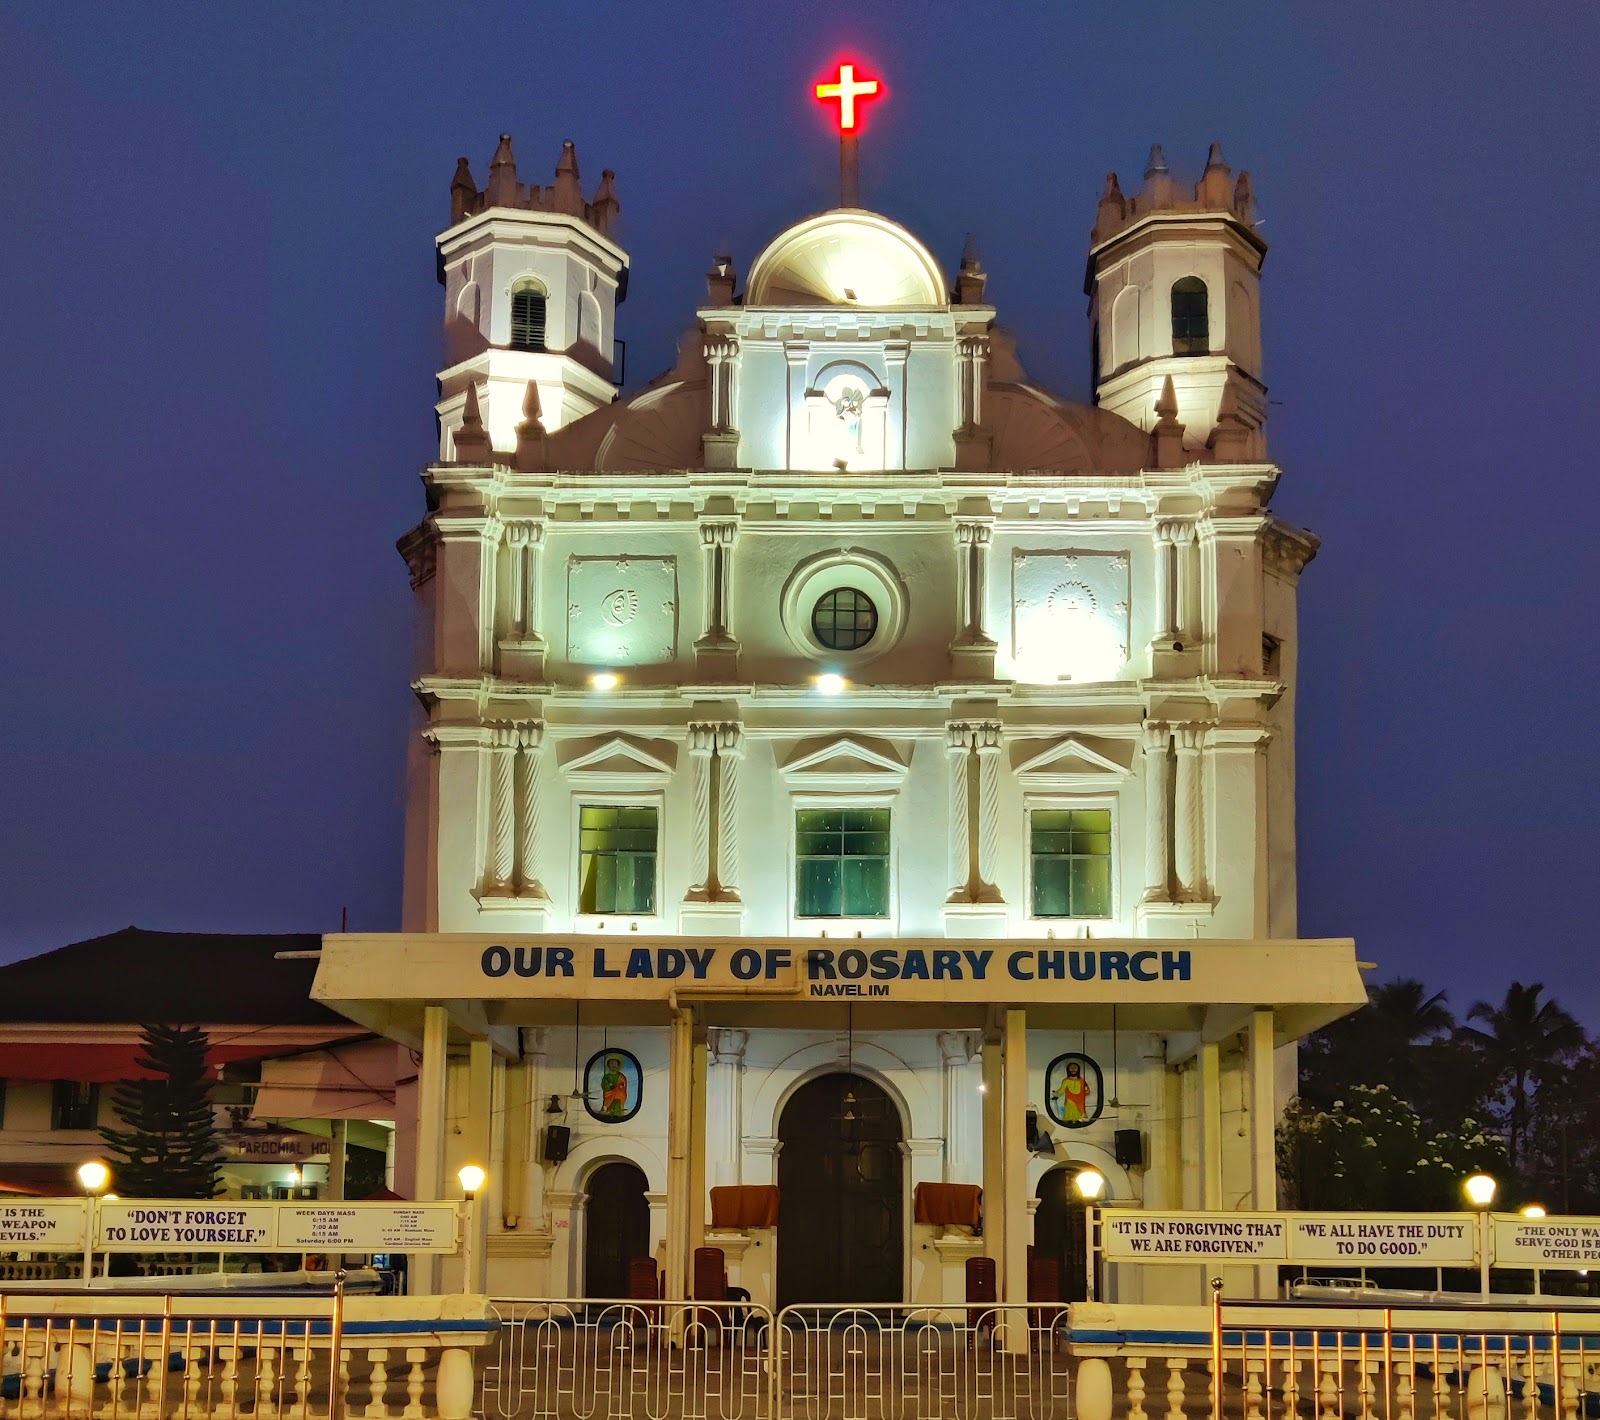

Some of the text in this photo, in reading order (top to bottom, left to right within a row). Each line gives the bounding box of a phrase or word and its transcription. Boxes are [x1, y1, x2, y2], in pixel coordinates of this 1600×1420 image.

[481, 946, 1192, 981] OUR LADY OF ROSARY CHURCH
[810, 984, 890, 996] NAVELIM
[238, 1141, 305, 1154] PAROCHIAL
[5, 1208, 17, 1217] IS
[20, 1208, 45, 1217] THE
[185, 1211, 247, 1225] FORGET
[1, 1220, 57, 1229] WEAPON
[1112, 1221, 1282, 1237] “IT IS IN FORGIVING THAT
[1299, 1224, 1464, 1238] “WE ALL HAVE THE DUTY
[106, 1227, 266, 1243] TO LOVE YOURSELF.”
[1518, 1226, 1600, 1238] “THE ONLY WA
[1130, 1239, 1264, 1253] WE ARE FORGIVEN.”
[1336, 1241, 1428, 1255] TO DO GOOD.”
[1515, 1237, 1552, 1247] SERVE
[1554, 1238, 1579, 1248] GOD
[1581, 1239, 1592, 1248] IS
[1543, 1249, 1581, 1259] OTHER
